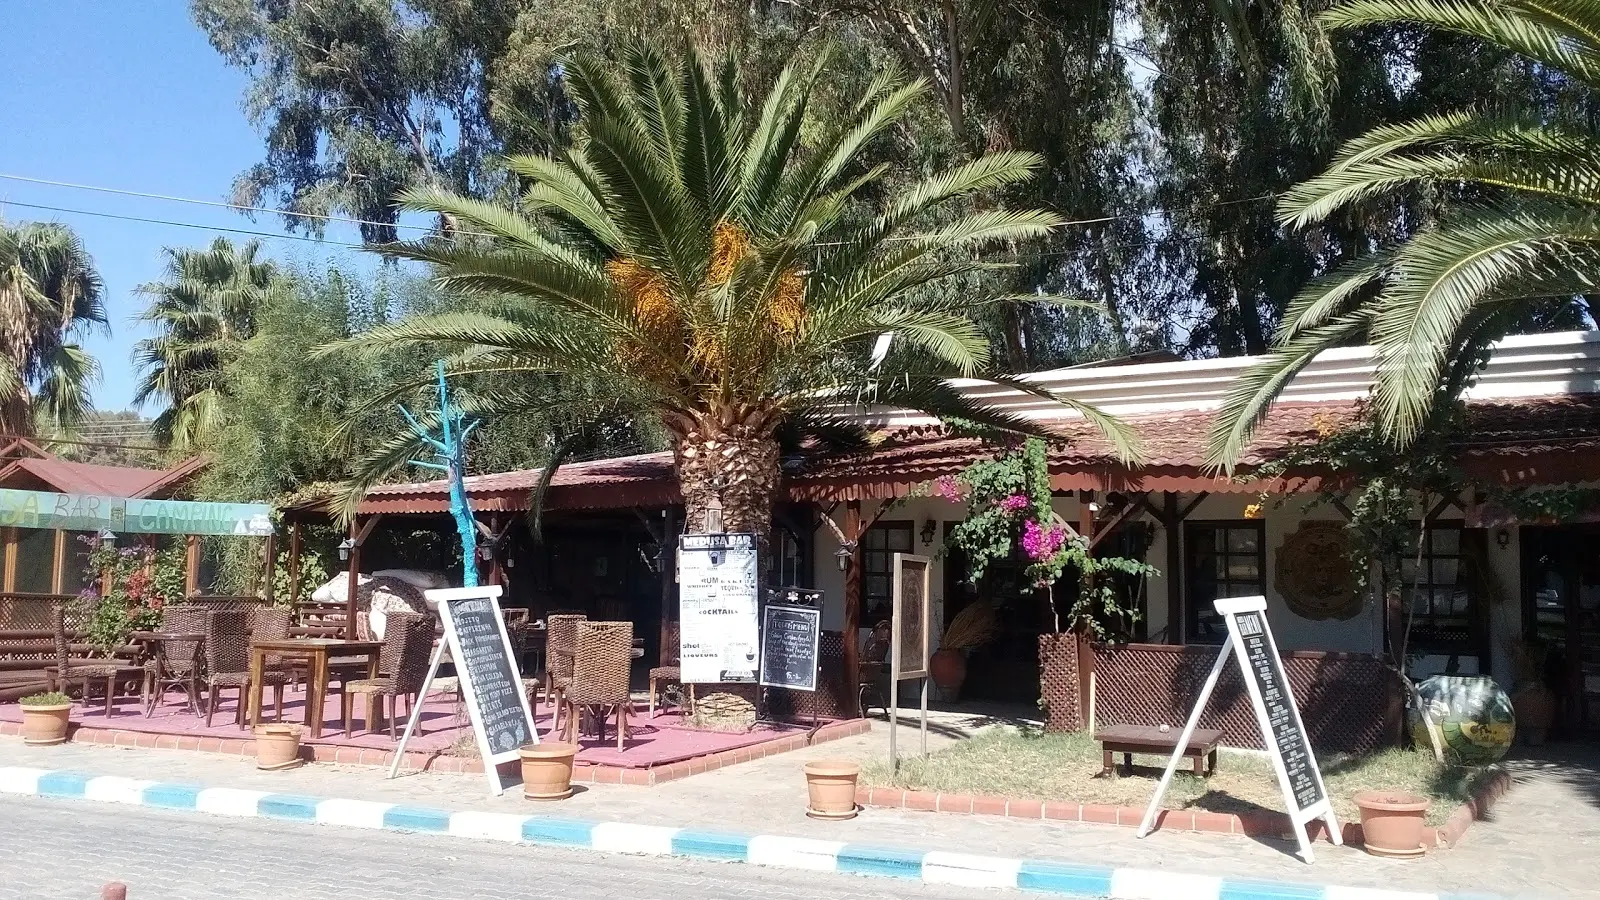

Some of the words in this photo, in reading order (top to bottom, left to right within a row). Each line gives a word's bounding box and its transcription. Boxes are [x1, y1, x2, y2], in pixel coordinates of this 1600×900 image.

[52, 494, 101, 521] BAR
[139, 501, 233, 533] CAMPING
[683, 536, 727, 547] MEDUSA
[728, 535, 752, 547] BAR
[454, 616, 480, 627] MOJITO
